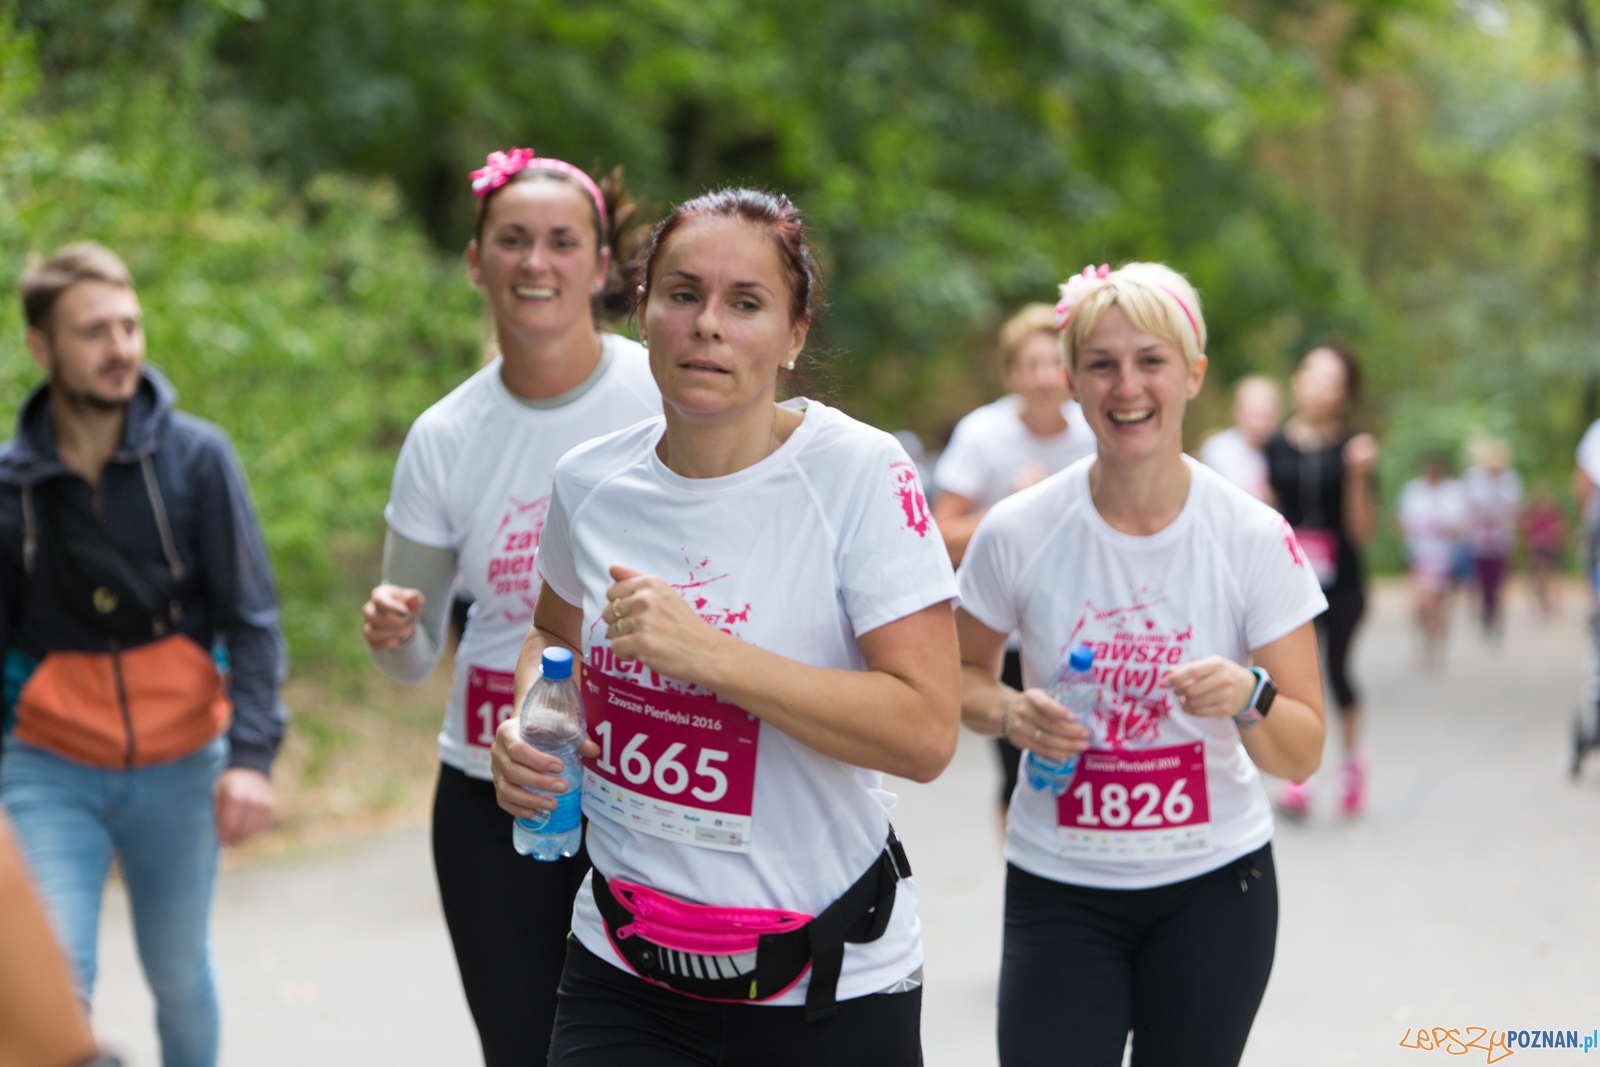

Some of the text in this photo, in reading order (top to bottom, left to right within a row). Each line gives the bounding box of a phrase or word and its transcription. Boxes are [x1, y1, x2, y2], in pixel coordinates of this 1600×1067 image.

[1081, 639, 1183, 664] awsze
[608, 692, 643, 714] Zawsze
[644, 704, 690, 725] Pier(w)si
[691, 715, 722, 731] 2016
[595, 720, 729, 802] 1665
[1073, 778, 1194, 827] 1826
